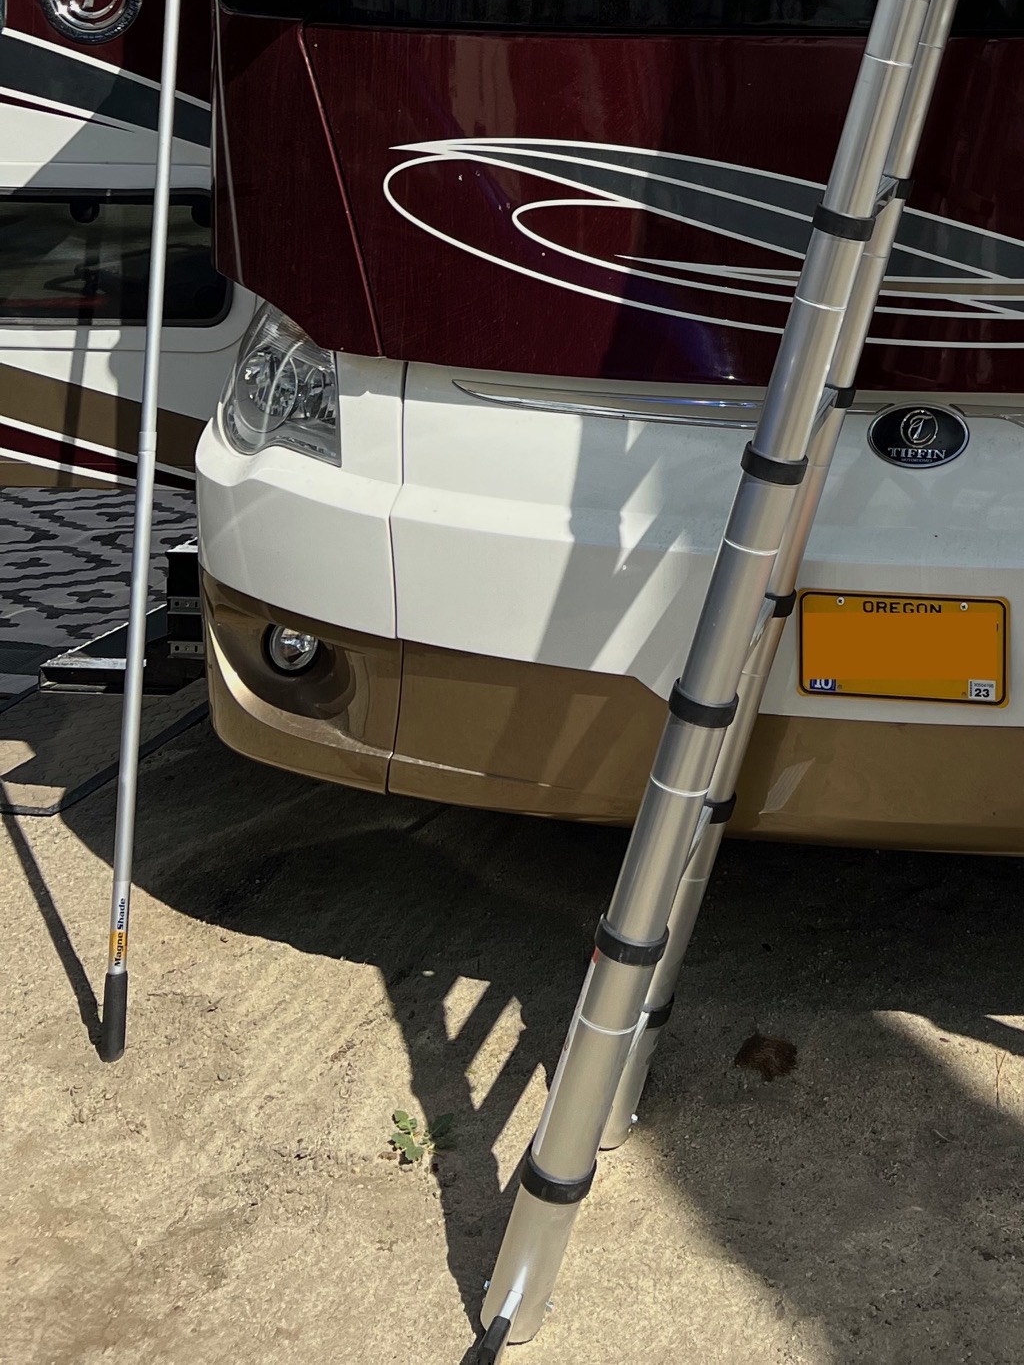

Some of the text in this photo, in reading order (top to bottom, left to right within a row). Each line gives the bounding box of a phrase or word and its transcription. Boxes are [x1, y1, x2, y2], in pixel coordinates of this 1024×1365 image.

[887, 447, 946, 459] TIFFIN
[863, 600, 942, 614] OREGON
[974, 688, 990, 698] 23
[114, 898, 126, 967] Magne Shade
